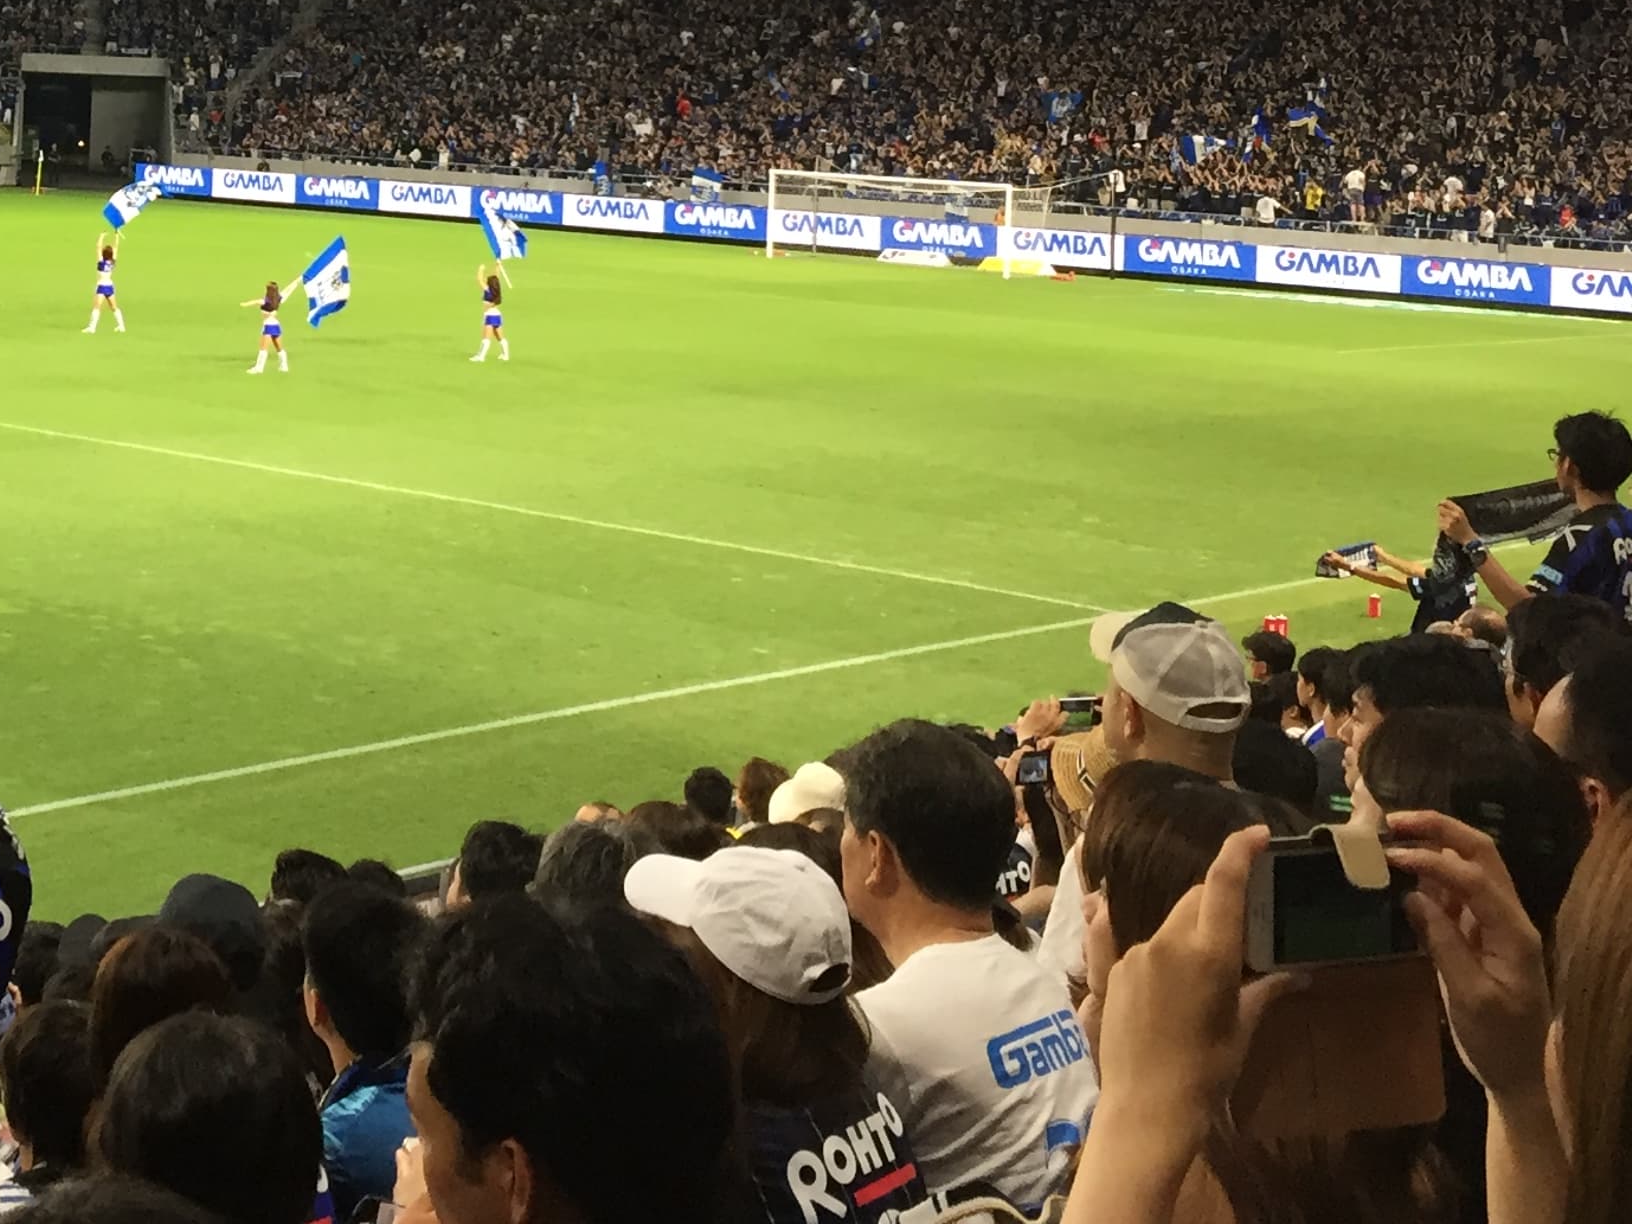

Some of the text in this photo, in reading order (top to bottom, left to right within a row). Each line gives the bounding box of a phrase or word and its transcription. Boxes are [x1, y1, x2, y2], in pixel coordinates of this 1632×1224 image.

[144, 165, 205, 187] GAMBA
[224, 172, 283, 192] GAMBA
[304, 177, 370, 200] GAMBA
[392, 184, 457, 204] GAMBA
[480, 189, 552, 214] GAMBA
[576, 198, 649, 220] GAMBA
[674, 203, 755, 229] GAMBA
[782, 213, 864, 237] GAMBA
[892, 220, 983, 248] GAMBA
[1013, 230, 1106, 256] GAMBA
[1138, 238, 1241, 268] GAMBA
[1171, 265, 1207, 275] OSAKA
[1275, 250, 1380, 278] GAMBA
[1417, 259, 1533, 292] GAMBA
[1455, 288, 1495, 299] OSAKA
[986, 1009, 1089, 1089] Gamb
[787, 1092, 904, 1224] ROHTO
